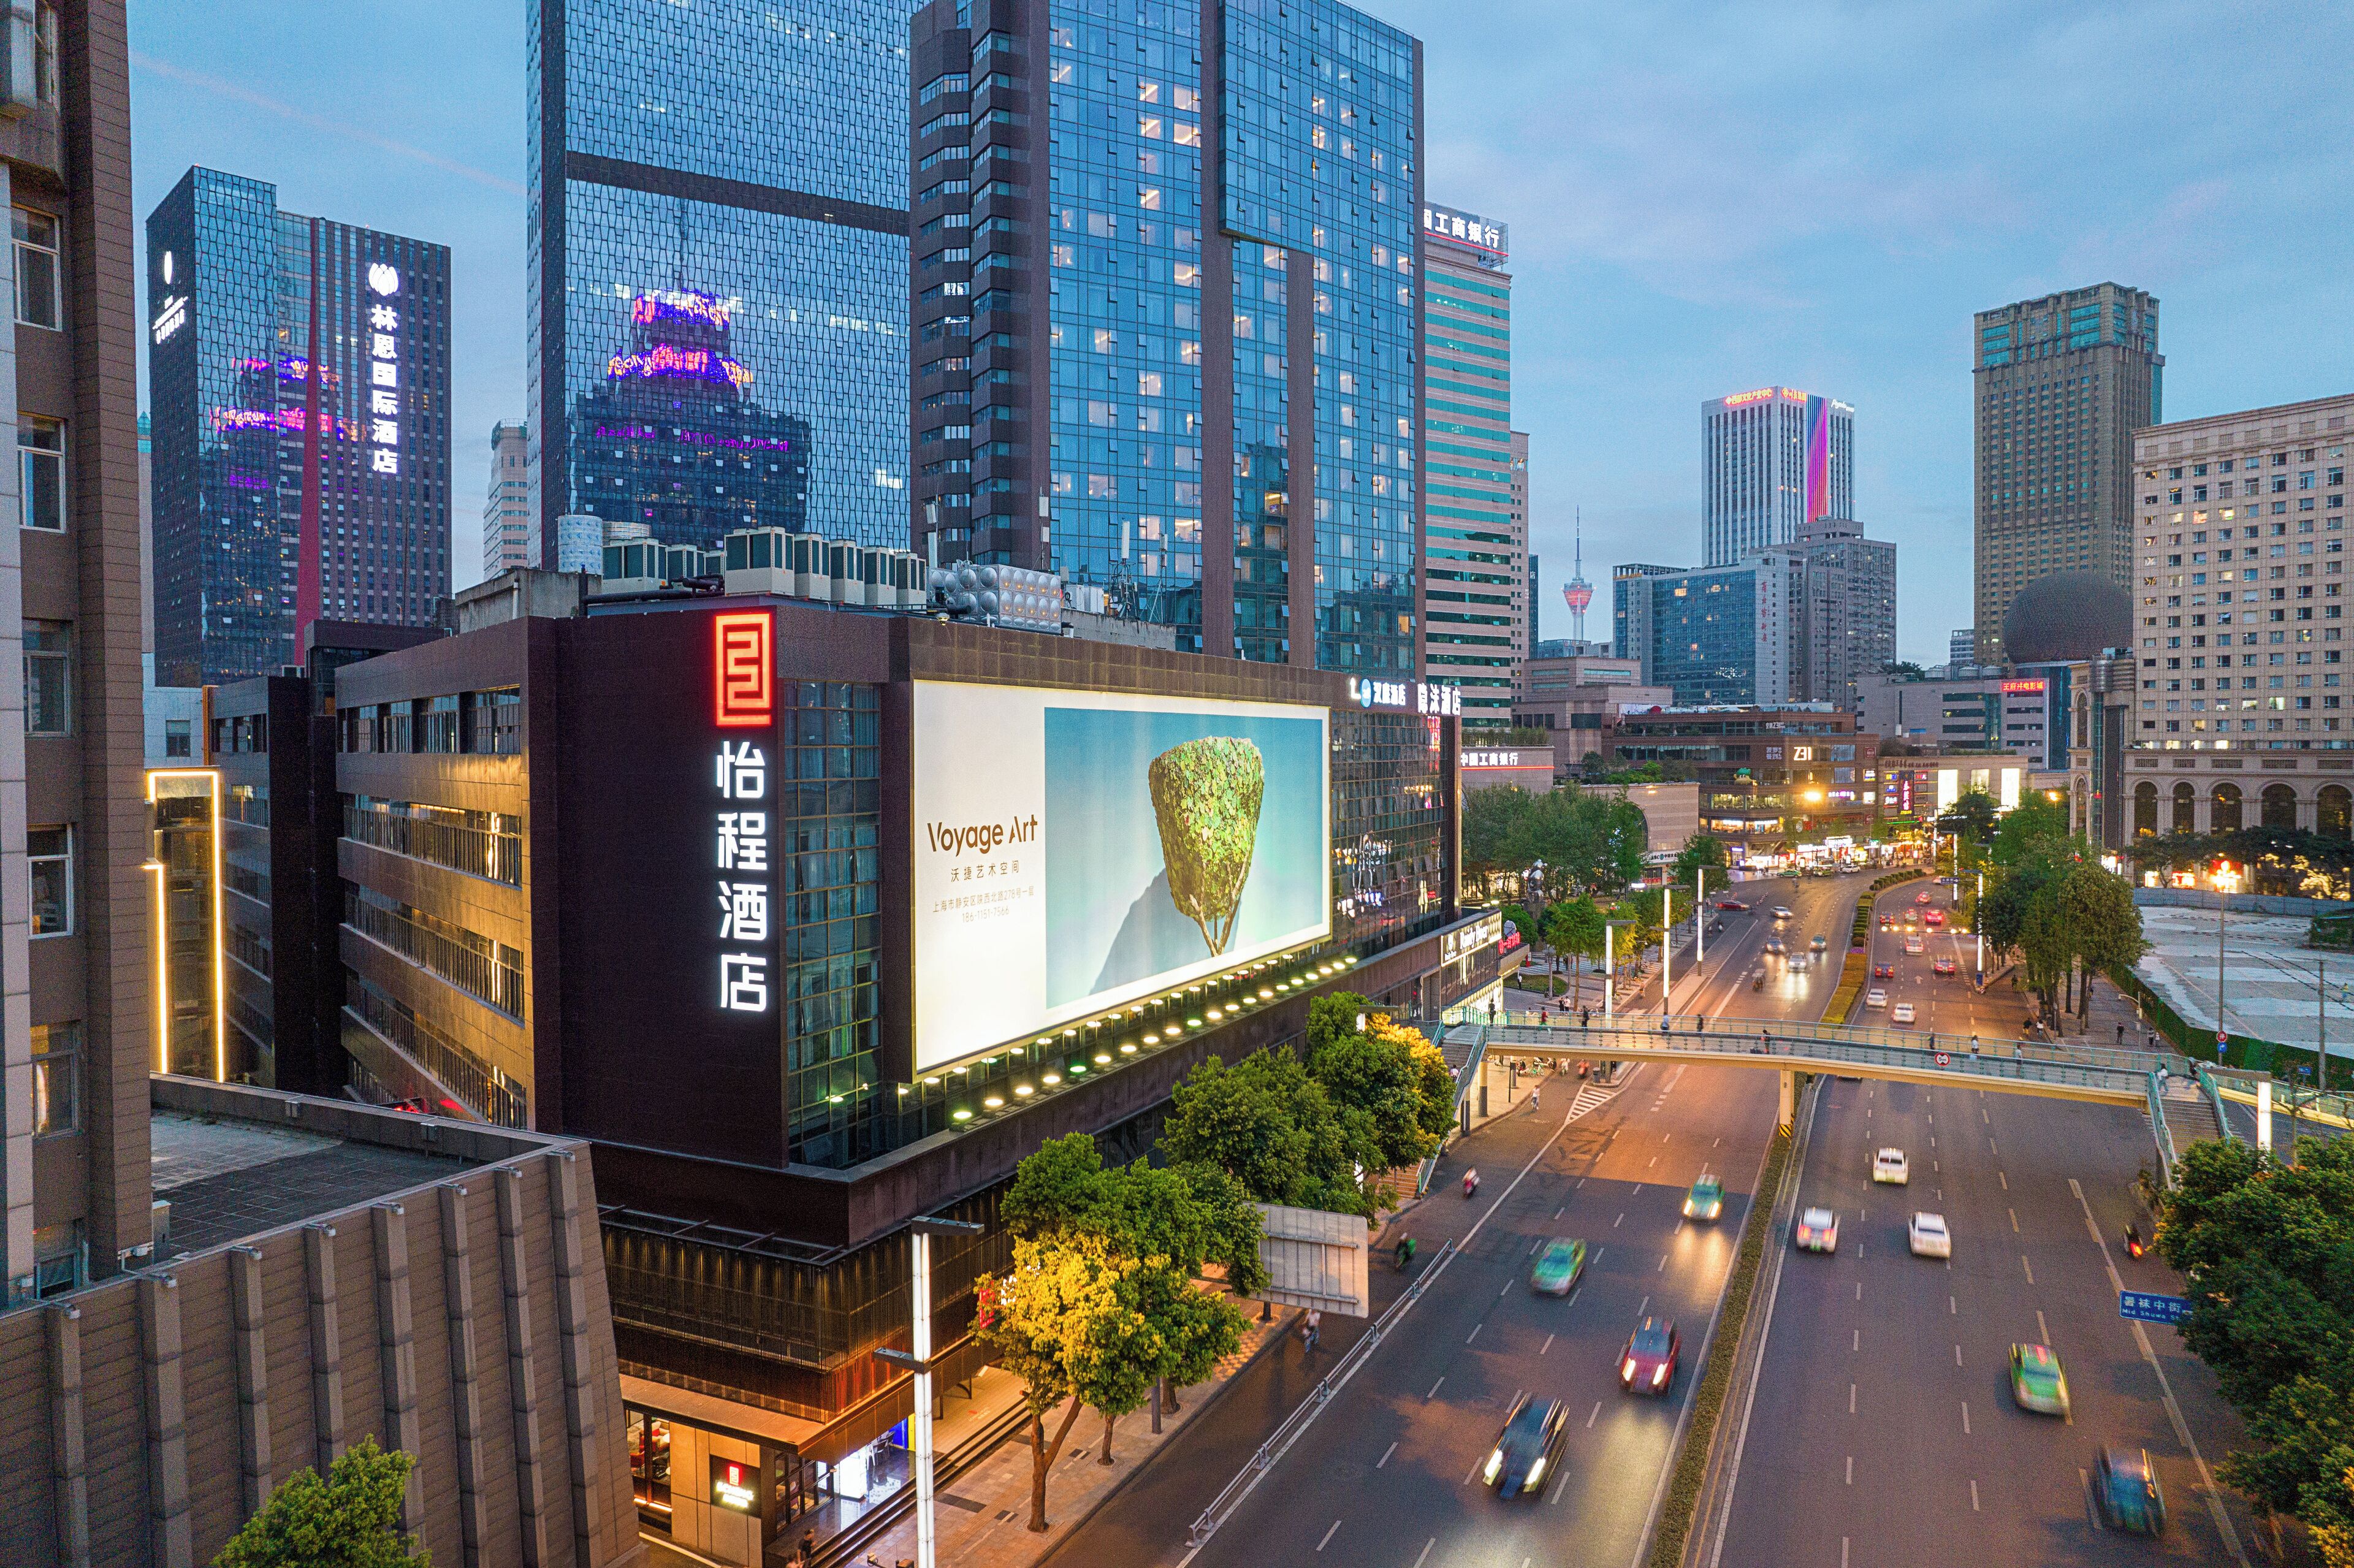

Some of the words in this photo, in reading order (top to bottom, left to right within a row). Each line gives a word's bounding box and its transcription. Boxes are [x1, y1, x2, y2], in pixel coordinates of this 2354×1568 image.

[371, 304, 397, 474] 林恩国际酒店
[1373, 682, 1406, 706] 汉庭酒店
[2003, 681, 2044, 690] 王府井电影城
[1461, 753, 1518, 766] 中国工商银行
[927, 822, 1004, 857] Voyage
[1008, 814, 1038, 843] Art
[717, 741, 768, 1013] 怡程酒店
[951, 860, 1019, 882] 沃捷艺术空间
[2140, 1311, 2166, 1319] Shuwa
